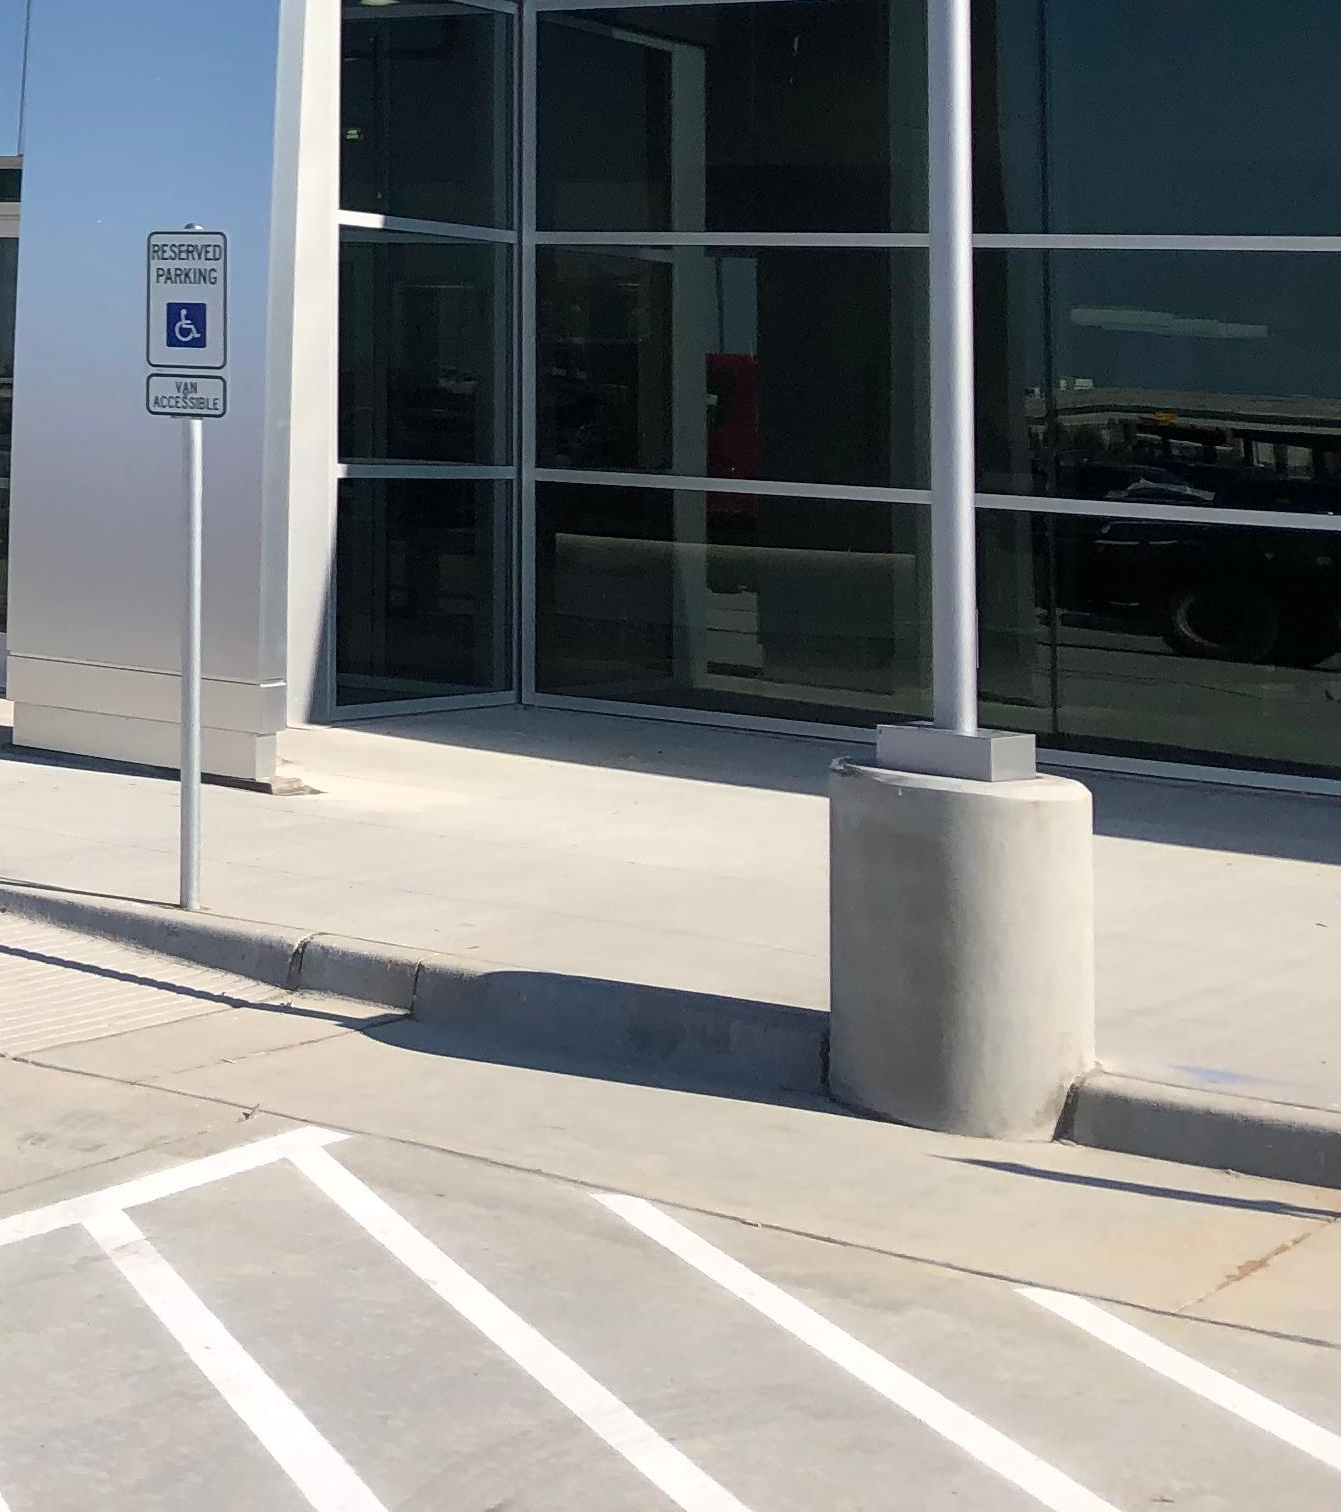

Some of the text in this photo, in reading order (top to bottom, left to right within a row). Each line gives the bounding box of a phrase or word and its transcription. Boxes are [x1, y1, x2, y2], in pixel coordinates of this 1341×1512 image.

[151, 243, 223, 262] RESERVED
[155, 267, 218, 286] PARKING
[175, 380, 199, 395] VAN
[152, 395, 220, 411] ACCESSIBLE
